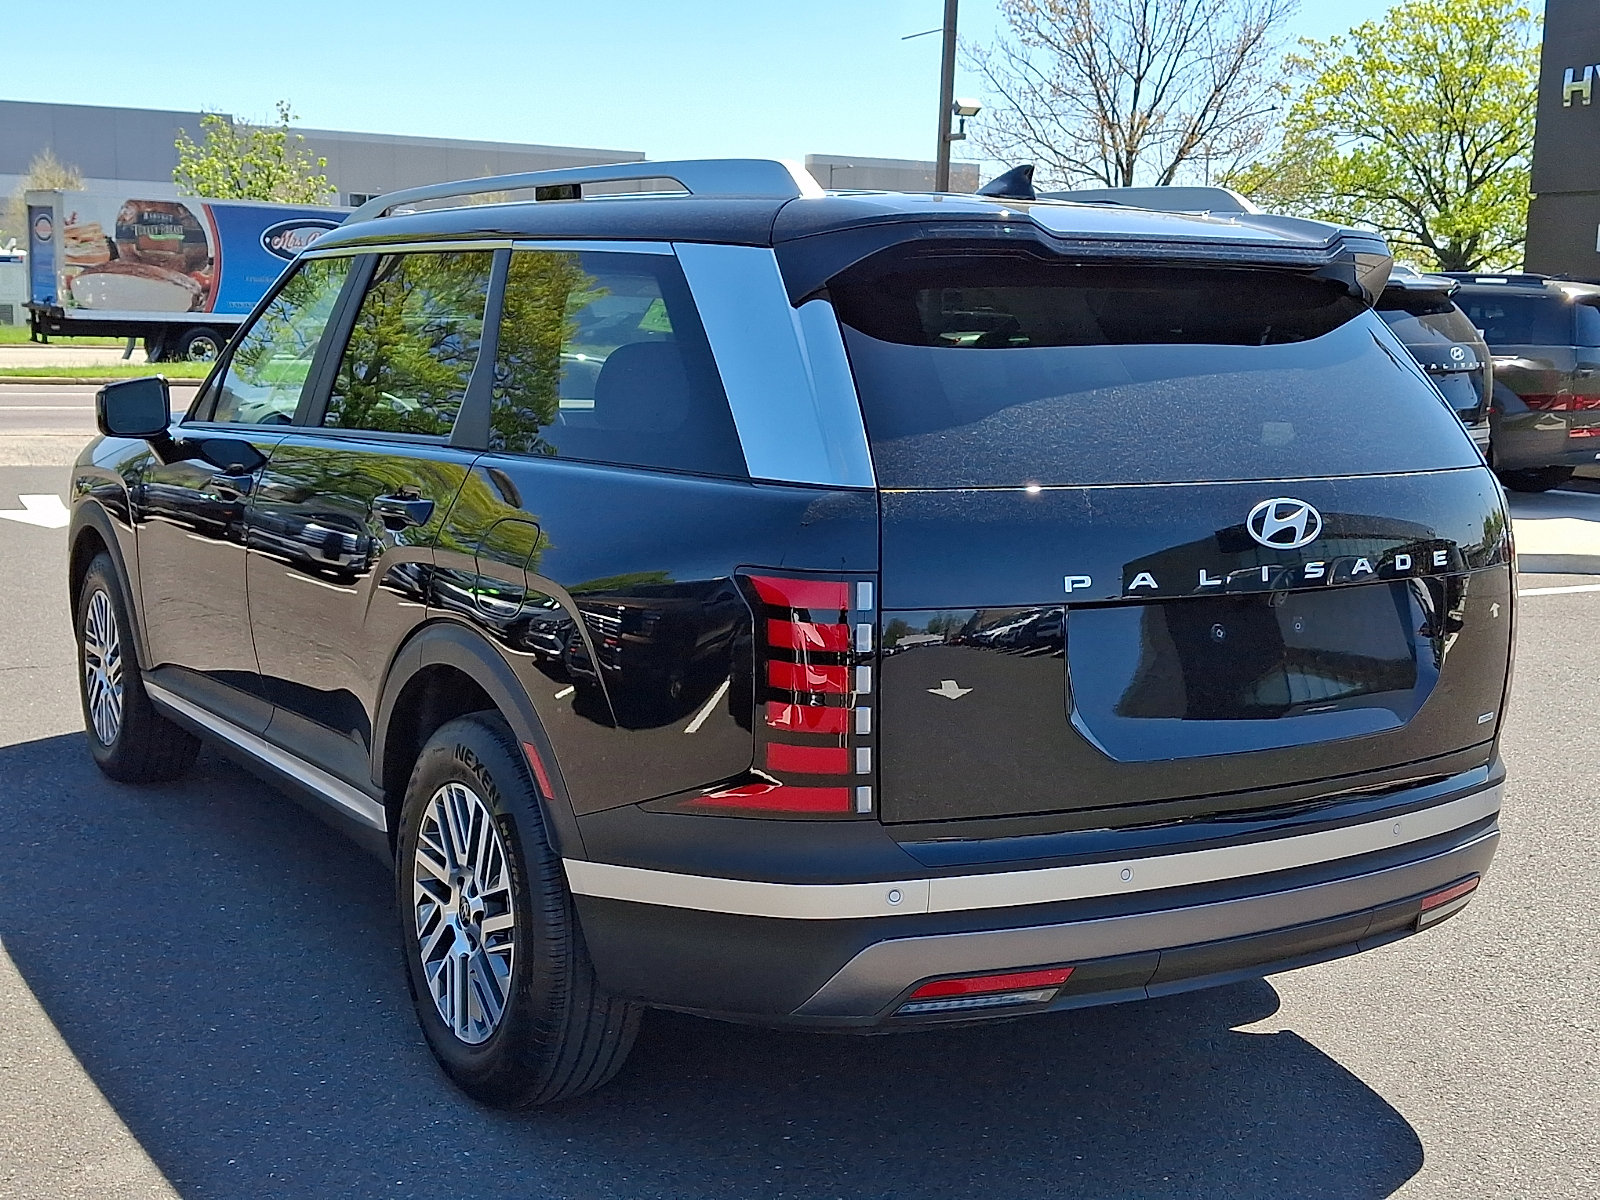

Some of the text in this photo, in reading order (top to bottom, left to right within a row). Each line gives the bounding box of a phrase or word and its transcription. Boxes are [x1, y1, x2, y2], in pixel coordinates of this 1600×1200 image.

[1563, 64, 1600, 107] H
[1064, 550, 1448, 593] PALISADE
[454, 743, 501, 808] NEXEN
